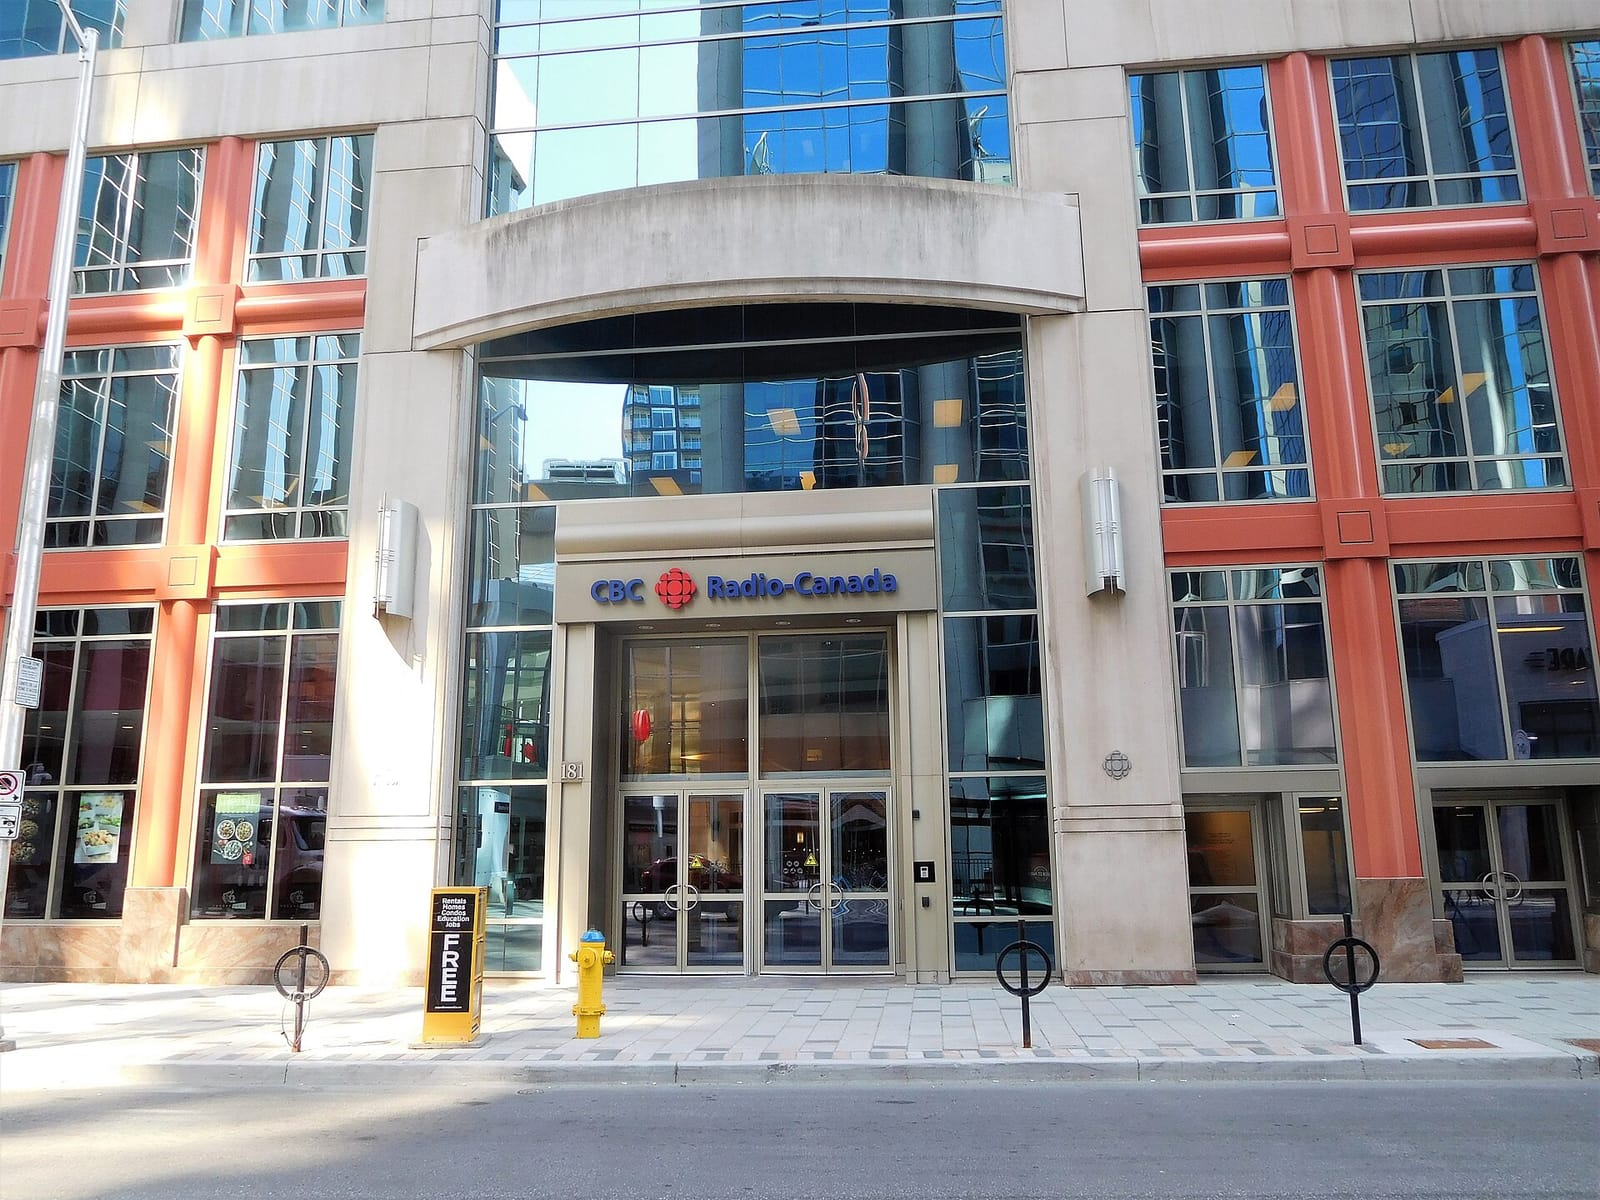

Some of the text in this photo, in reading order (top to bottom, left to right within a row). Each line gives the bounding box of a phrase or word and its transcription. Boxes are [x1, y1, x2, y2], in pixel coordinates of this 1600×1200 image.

[590, 568, 897, 602] CBC Radio-Canada
[561, 763, 584, 779] 181
[440, 933, 460, 1002] FREE
